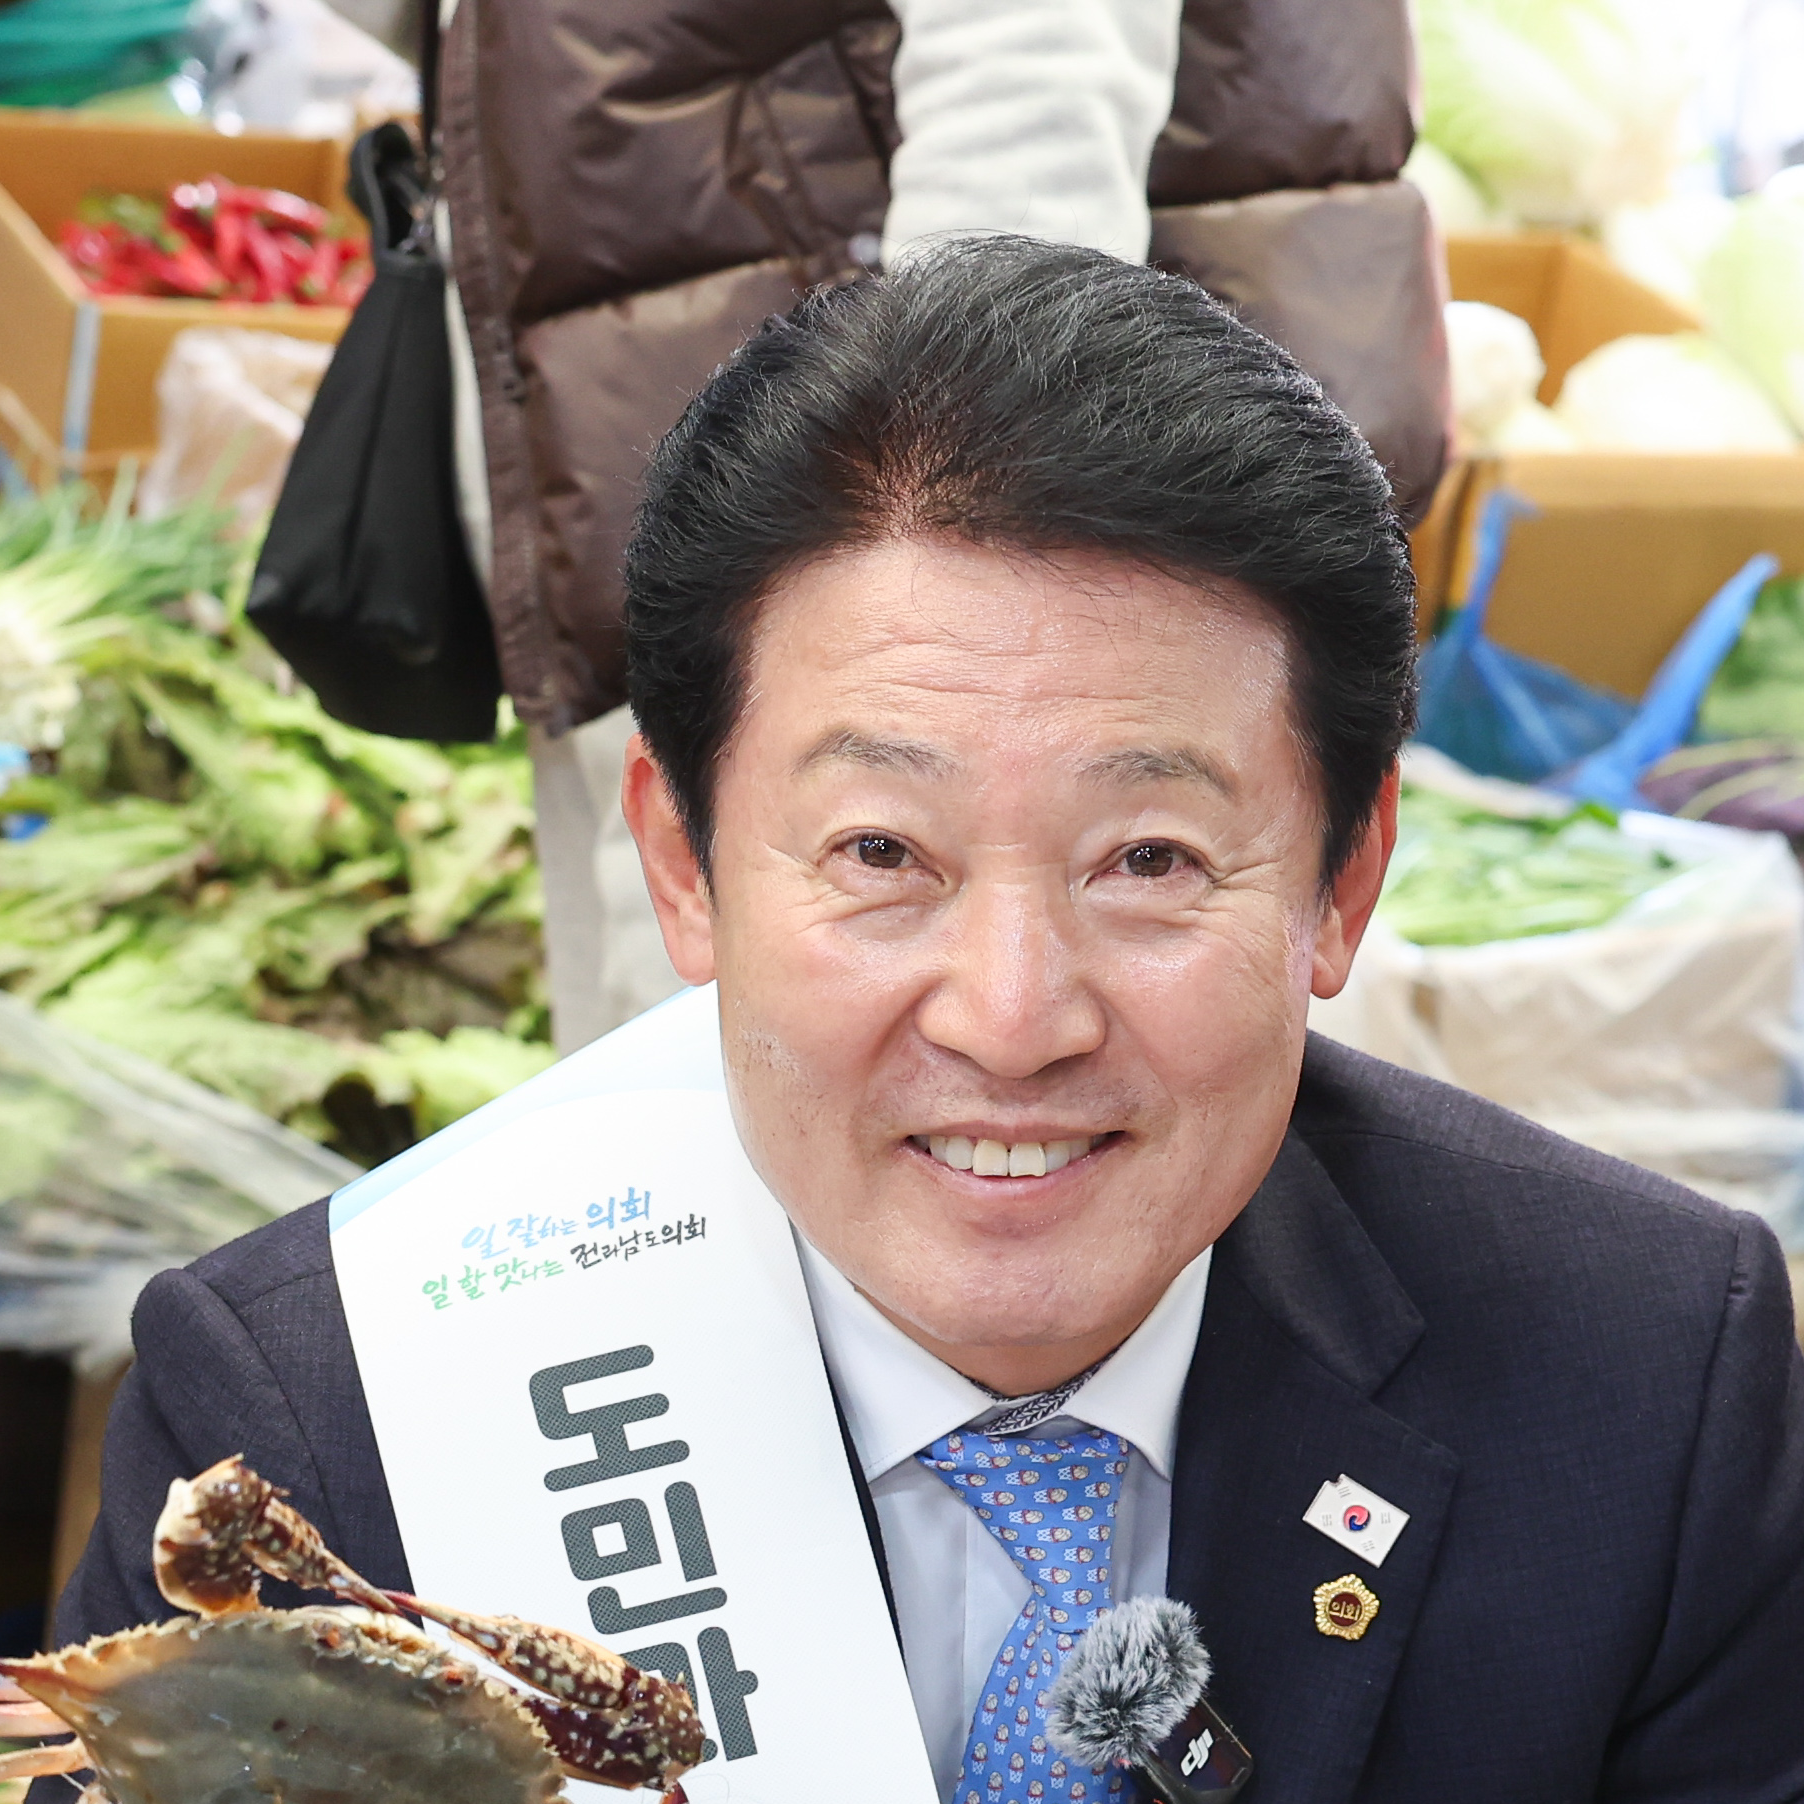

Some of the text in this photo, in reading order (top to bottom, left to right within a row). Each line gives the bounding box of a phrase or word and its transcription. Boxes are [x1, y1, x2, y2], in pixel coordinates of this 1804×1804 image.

[460, 1186, 651, 1260] 일 잘하는 의회
[421, 1274, 453, 1311] 일
[457, 1264, 487, 1301] 할
[570, 1213, 707, 1270] 전라남도의회
[1328, 1600, 1361, 1621] 의회
